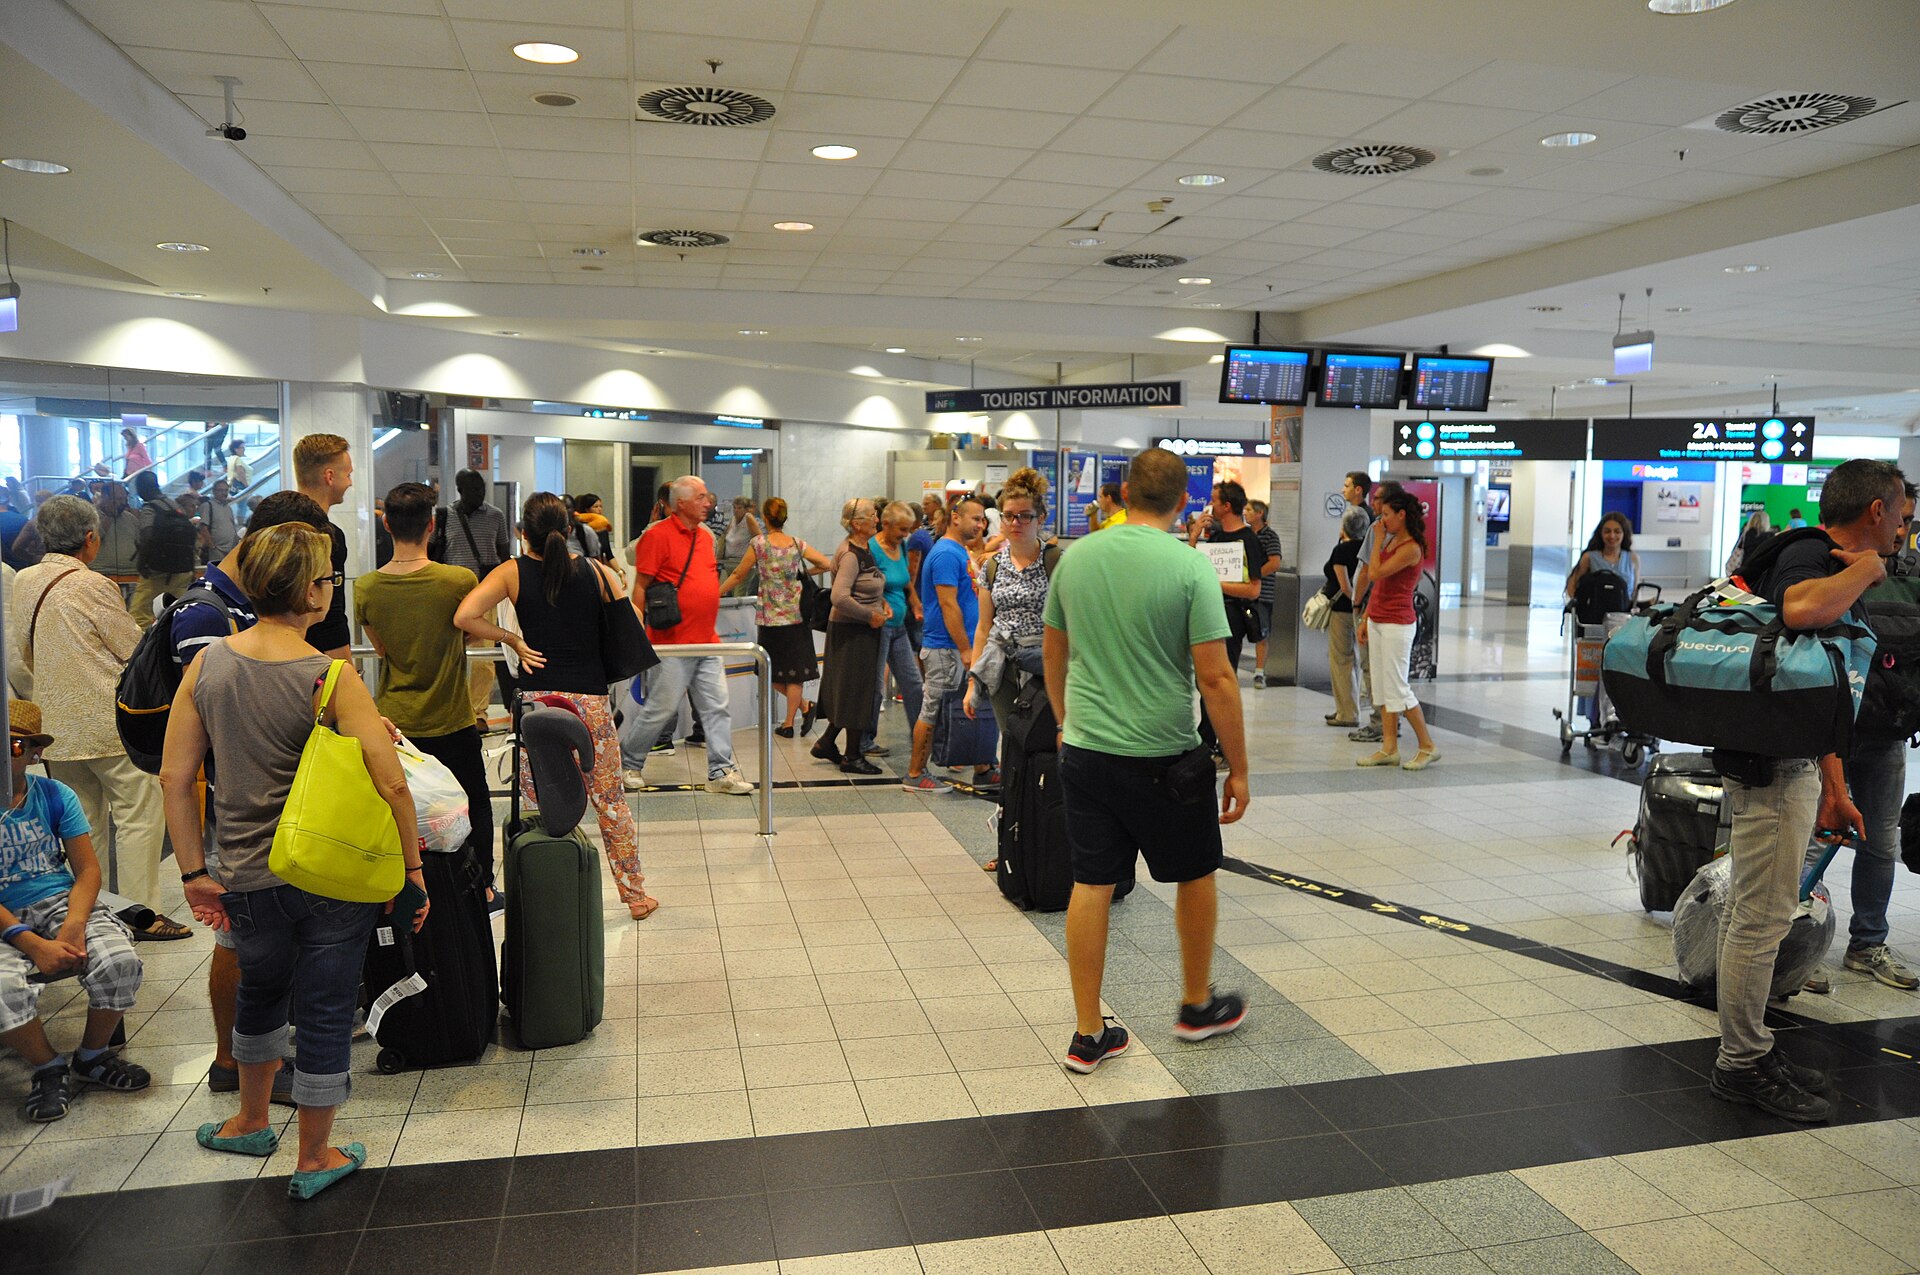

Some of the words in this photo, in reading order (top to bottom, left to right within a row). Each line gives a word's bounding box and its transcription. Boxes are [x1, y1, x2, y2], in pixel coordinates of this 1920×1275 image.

[981, 391, 1047, 408] TOURIST
[1052, 386, 1171, 405] INFORMATION
[1692, 422, 1718, 439] 2A
[1186, 465, 1208, 475] PEST
[1644, 465, 1678, 481] Budget
[1741, 502, 1764, 511] rprise
[1269, 874, 1344, 897] TAXI
